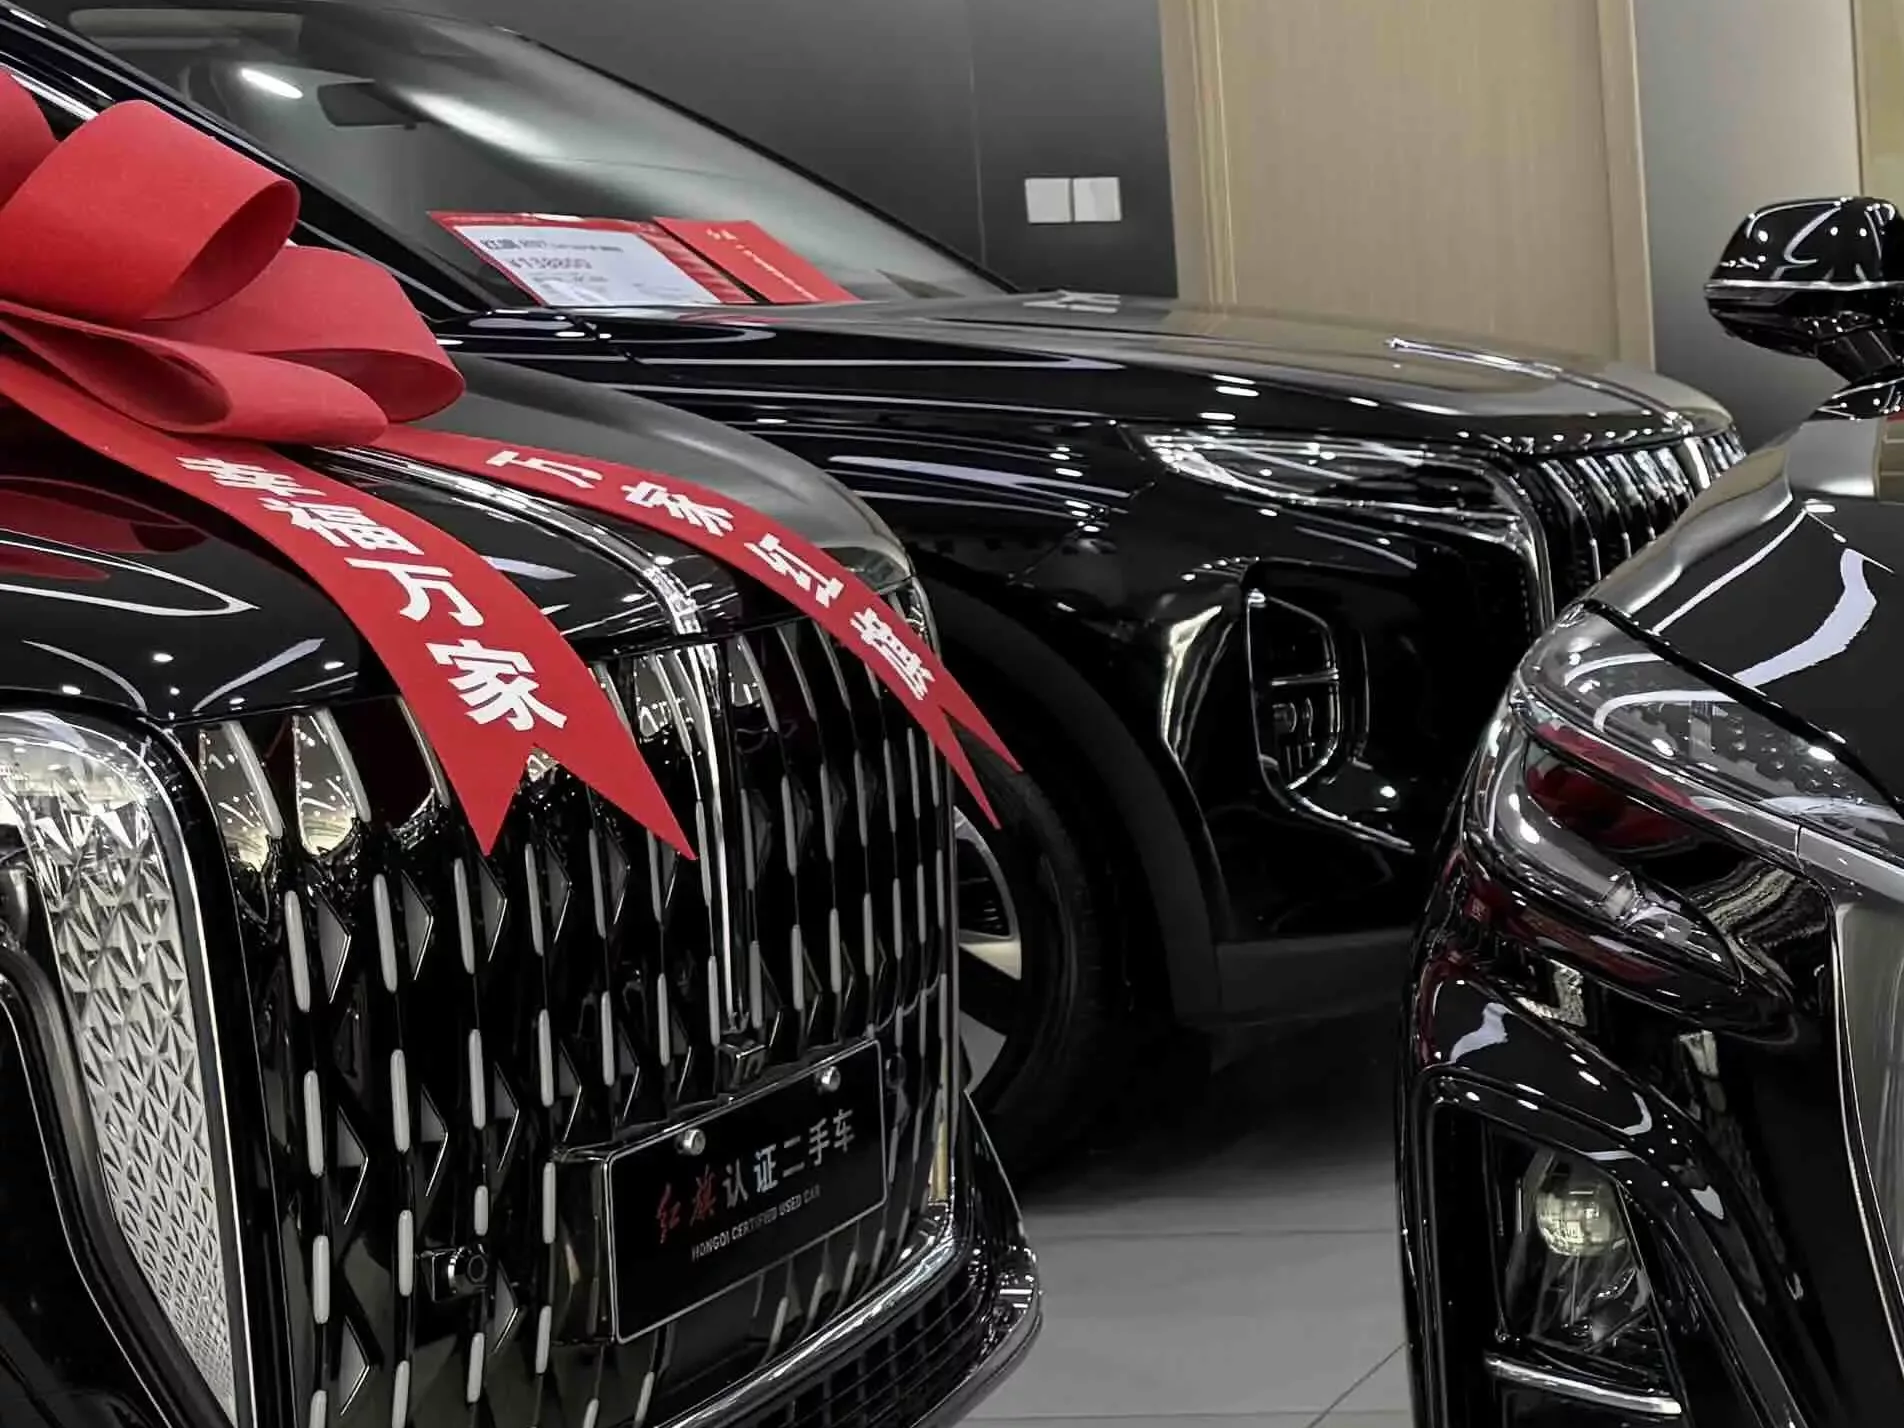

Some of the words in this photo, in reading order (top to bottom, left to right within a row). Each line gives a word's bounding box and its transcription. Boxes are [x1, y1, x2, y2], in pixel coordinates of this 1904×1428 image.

[485, 450, 937, 701] 万家红旗
[655, 1108, 856, 1245] 红旗认证二手车
